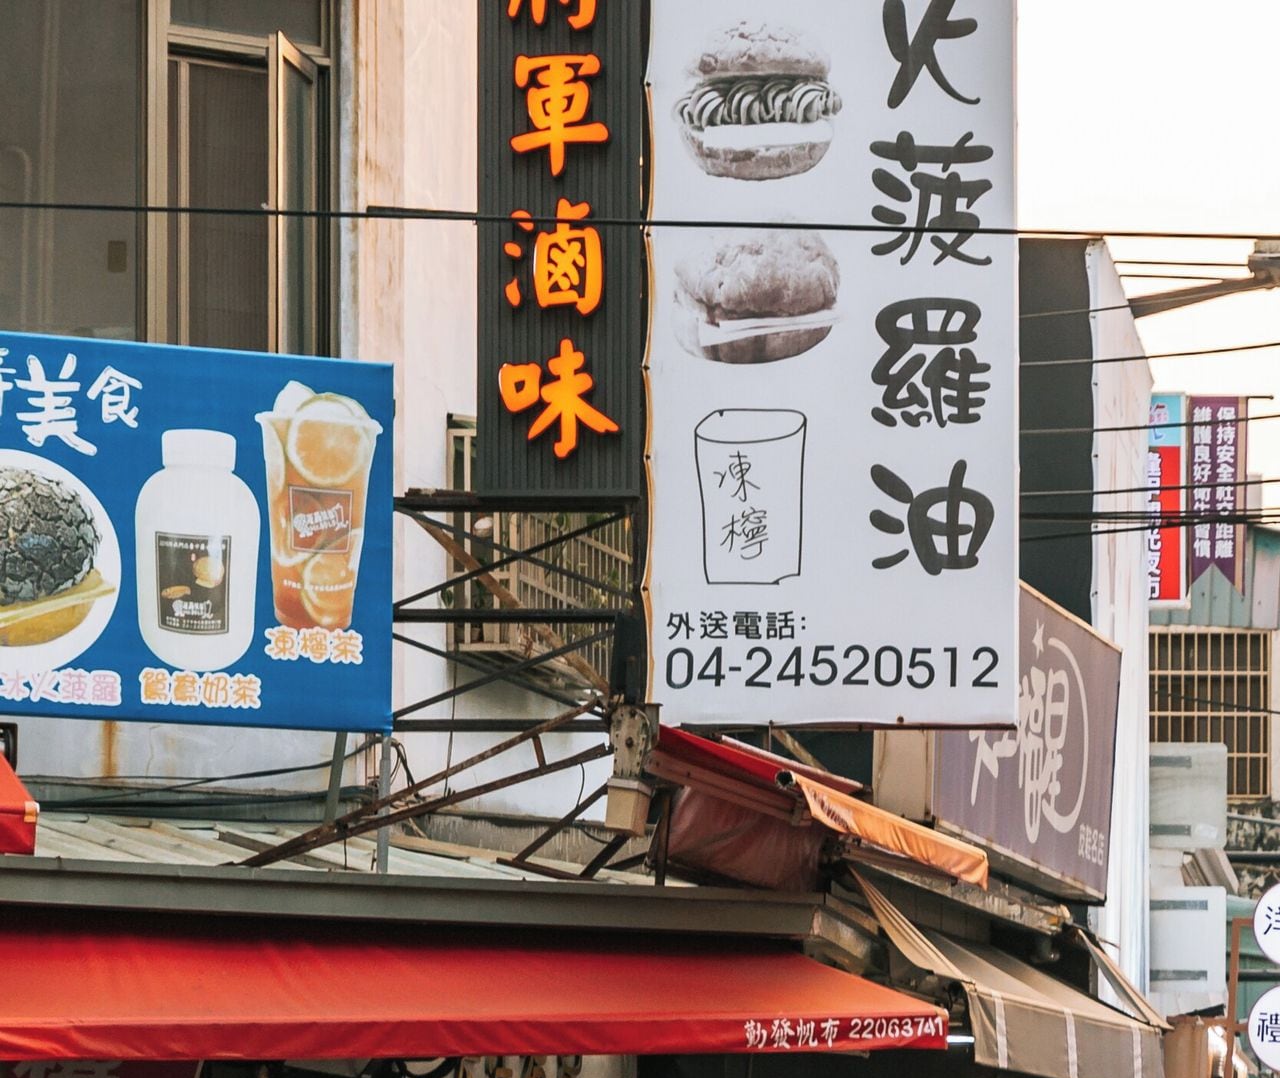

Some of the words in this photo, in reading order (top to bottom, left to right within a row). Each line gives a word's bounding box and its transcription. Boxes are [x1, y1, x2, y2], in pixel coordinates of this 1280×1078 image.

[500, 0, 621, 460] 軍滷味
[664, 645, 1001, 690] 04-24520512
[849, 1017, 944, 1039] 22063741
